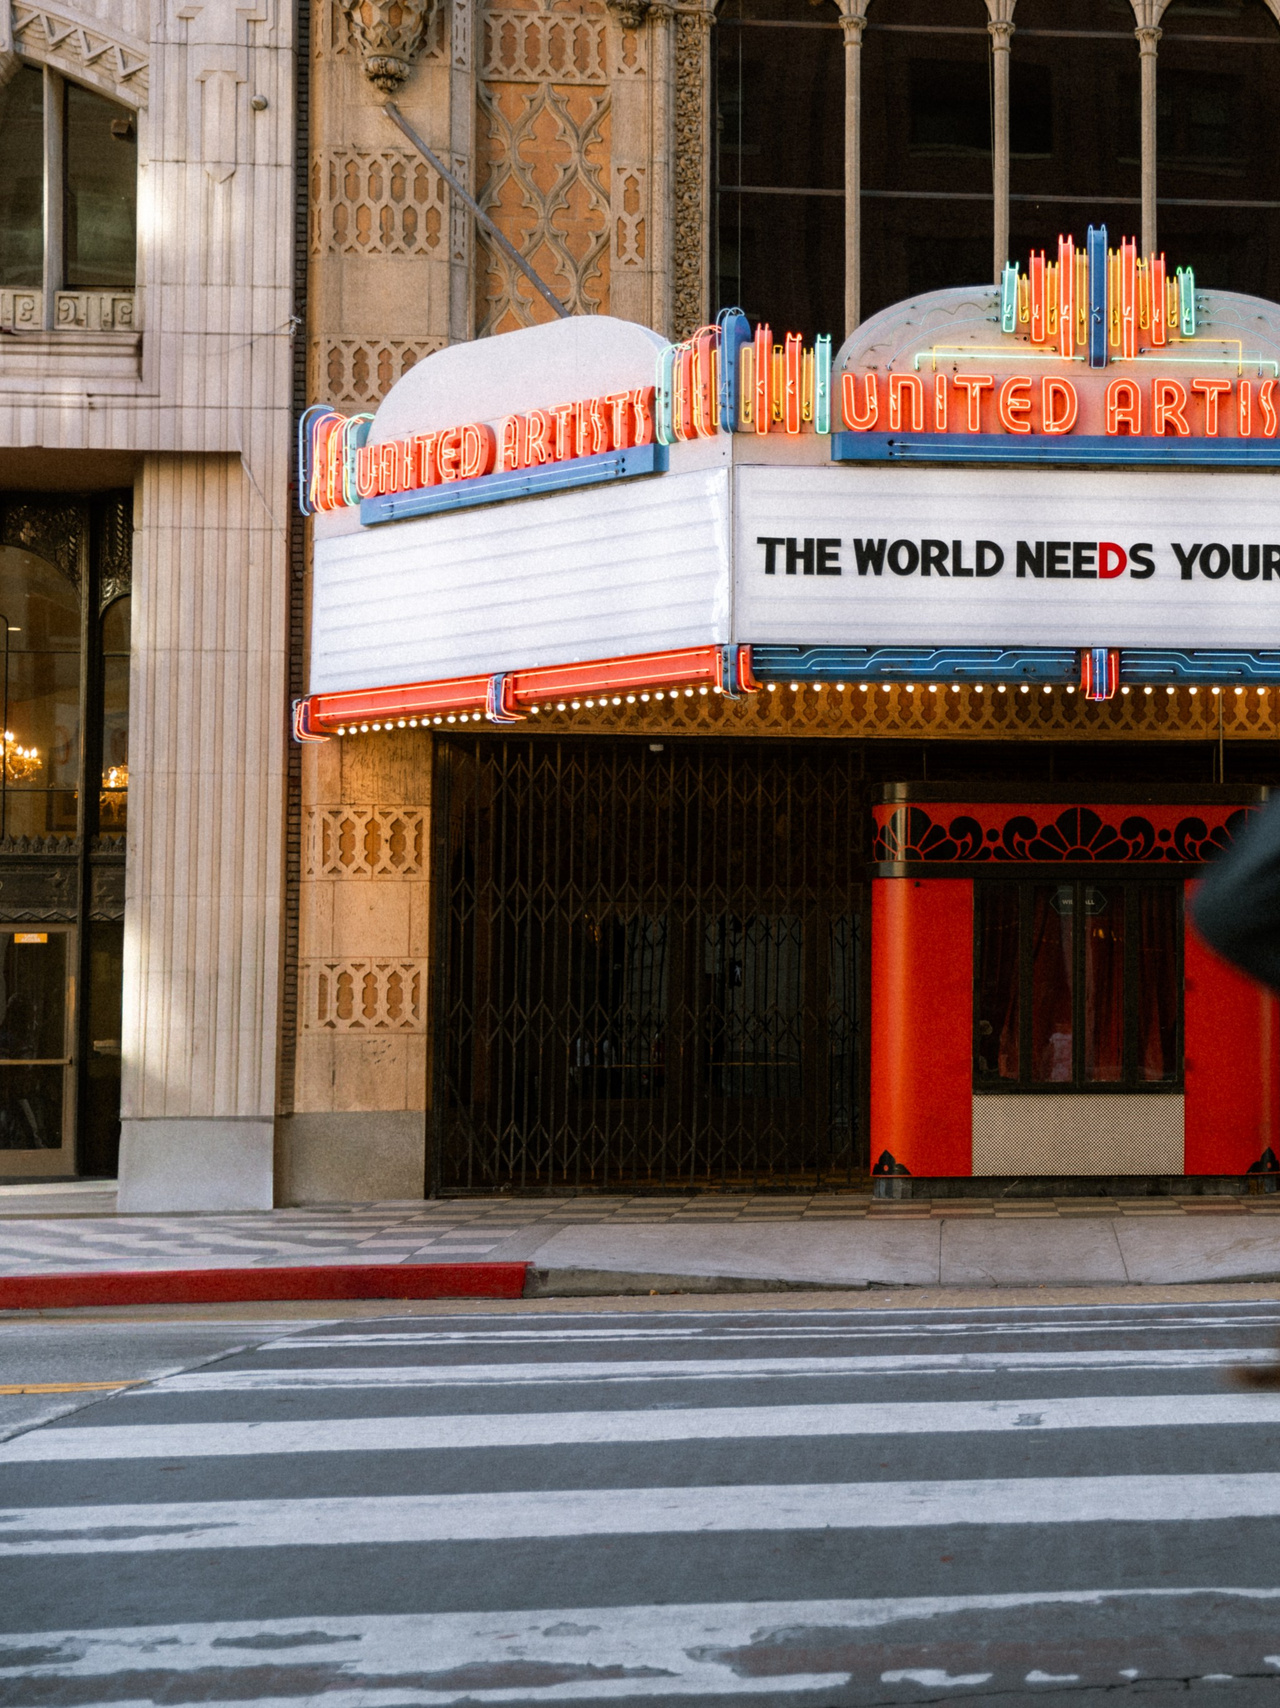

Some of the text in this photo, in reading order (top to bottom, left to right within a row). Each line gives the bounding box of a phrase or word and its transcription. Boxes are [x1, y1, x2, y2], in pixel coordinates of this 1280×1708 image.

[841, 373, 1078, 435] UNITED
[355, 386, 656, 498] UNITED ARTISTS
[756, 536, 842, 576] THE
[852, 538, 1005, 578] WORLD
[1016, 540, 1156, 580] NEEDS
